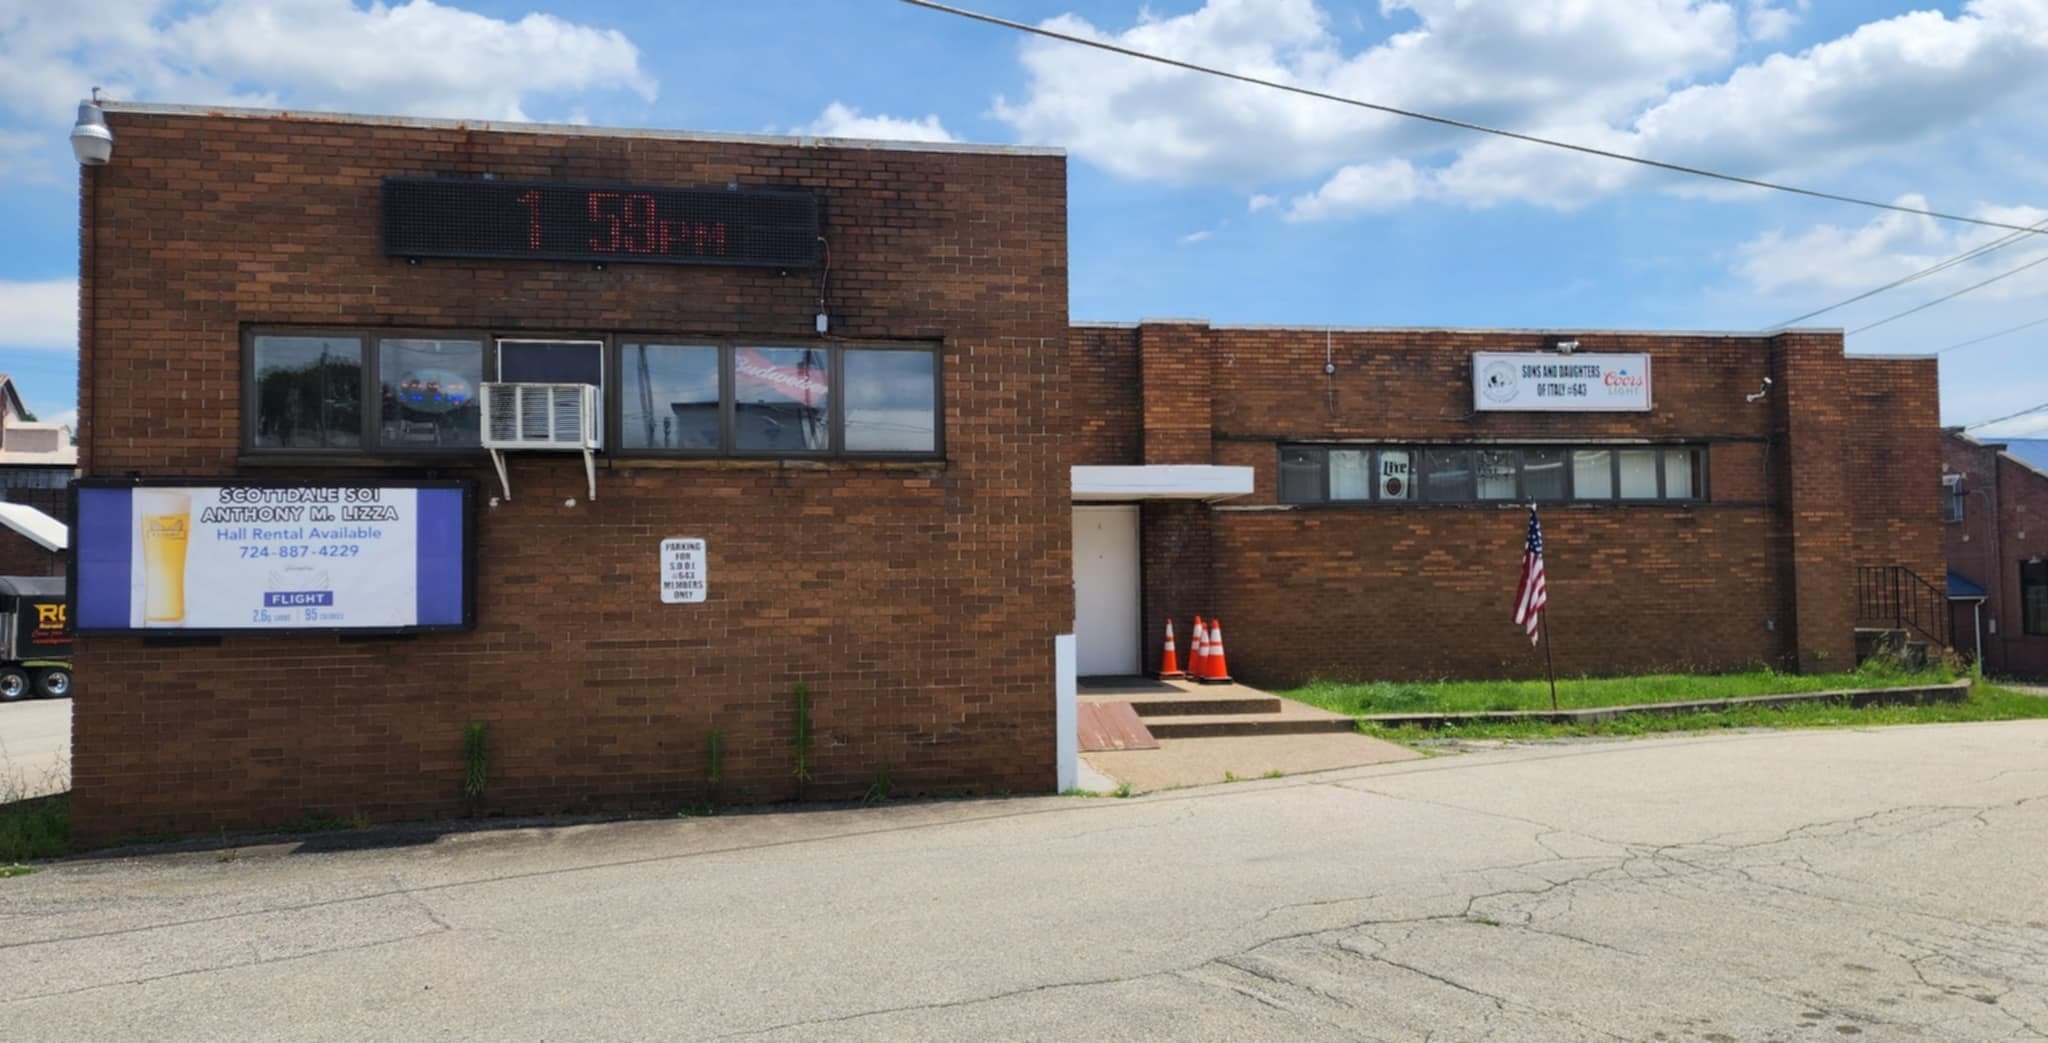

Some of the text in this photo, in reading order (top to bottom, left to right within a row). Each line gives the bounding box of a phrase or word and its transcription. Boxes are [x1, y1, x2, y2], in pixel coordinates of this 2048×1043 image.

[517, 190, 540, 249] 1
[1522, 364, 1600, 378] SONS AND DAUGHTERS
[1603, 370, 1642, 386] Coors
[1537, 383, 1546, 397] OF
[1547, 383, 1566, 397] ITALY
[1608, 387, 1639, 395] LIGHT
[1384, 460, 1407, 476] Lite
[219, 488, 380, 503] SCOTTDALE SOI
[200, 505, 399, 523] ANTHONY M. LIZZA
[217, 527, 382, 541] Hall Rental Available
[665, 542, 701, 551] PARKING
[675, 552, 691, 561] FOR
[663, 580, 704, 590] MEMBERS
[272, 593, 325, 605] FLIGHT
[673, 591, 693, 600] ONLY
[305, 608, 318, 621] 95
